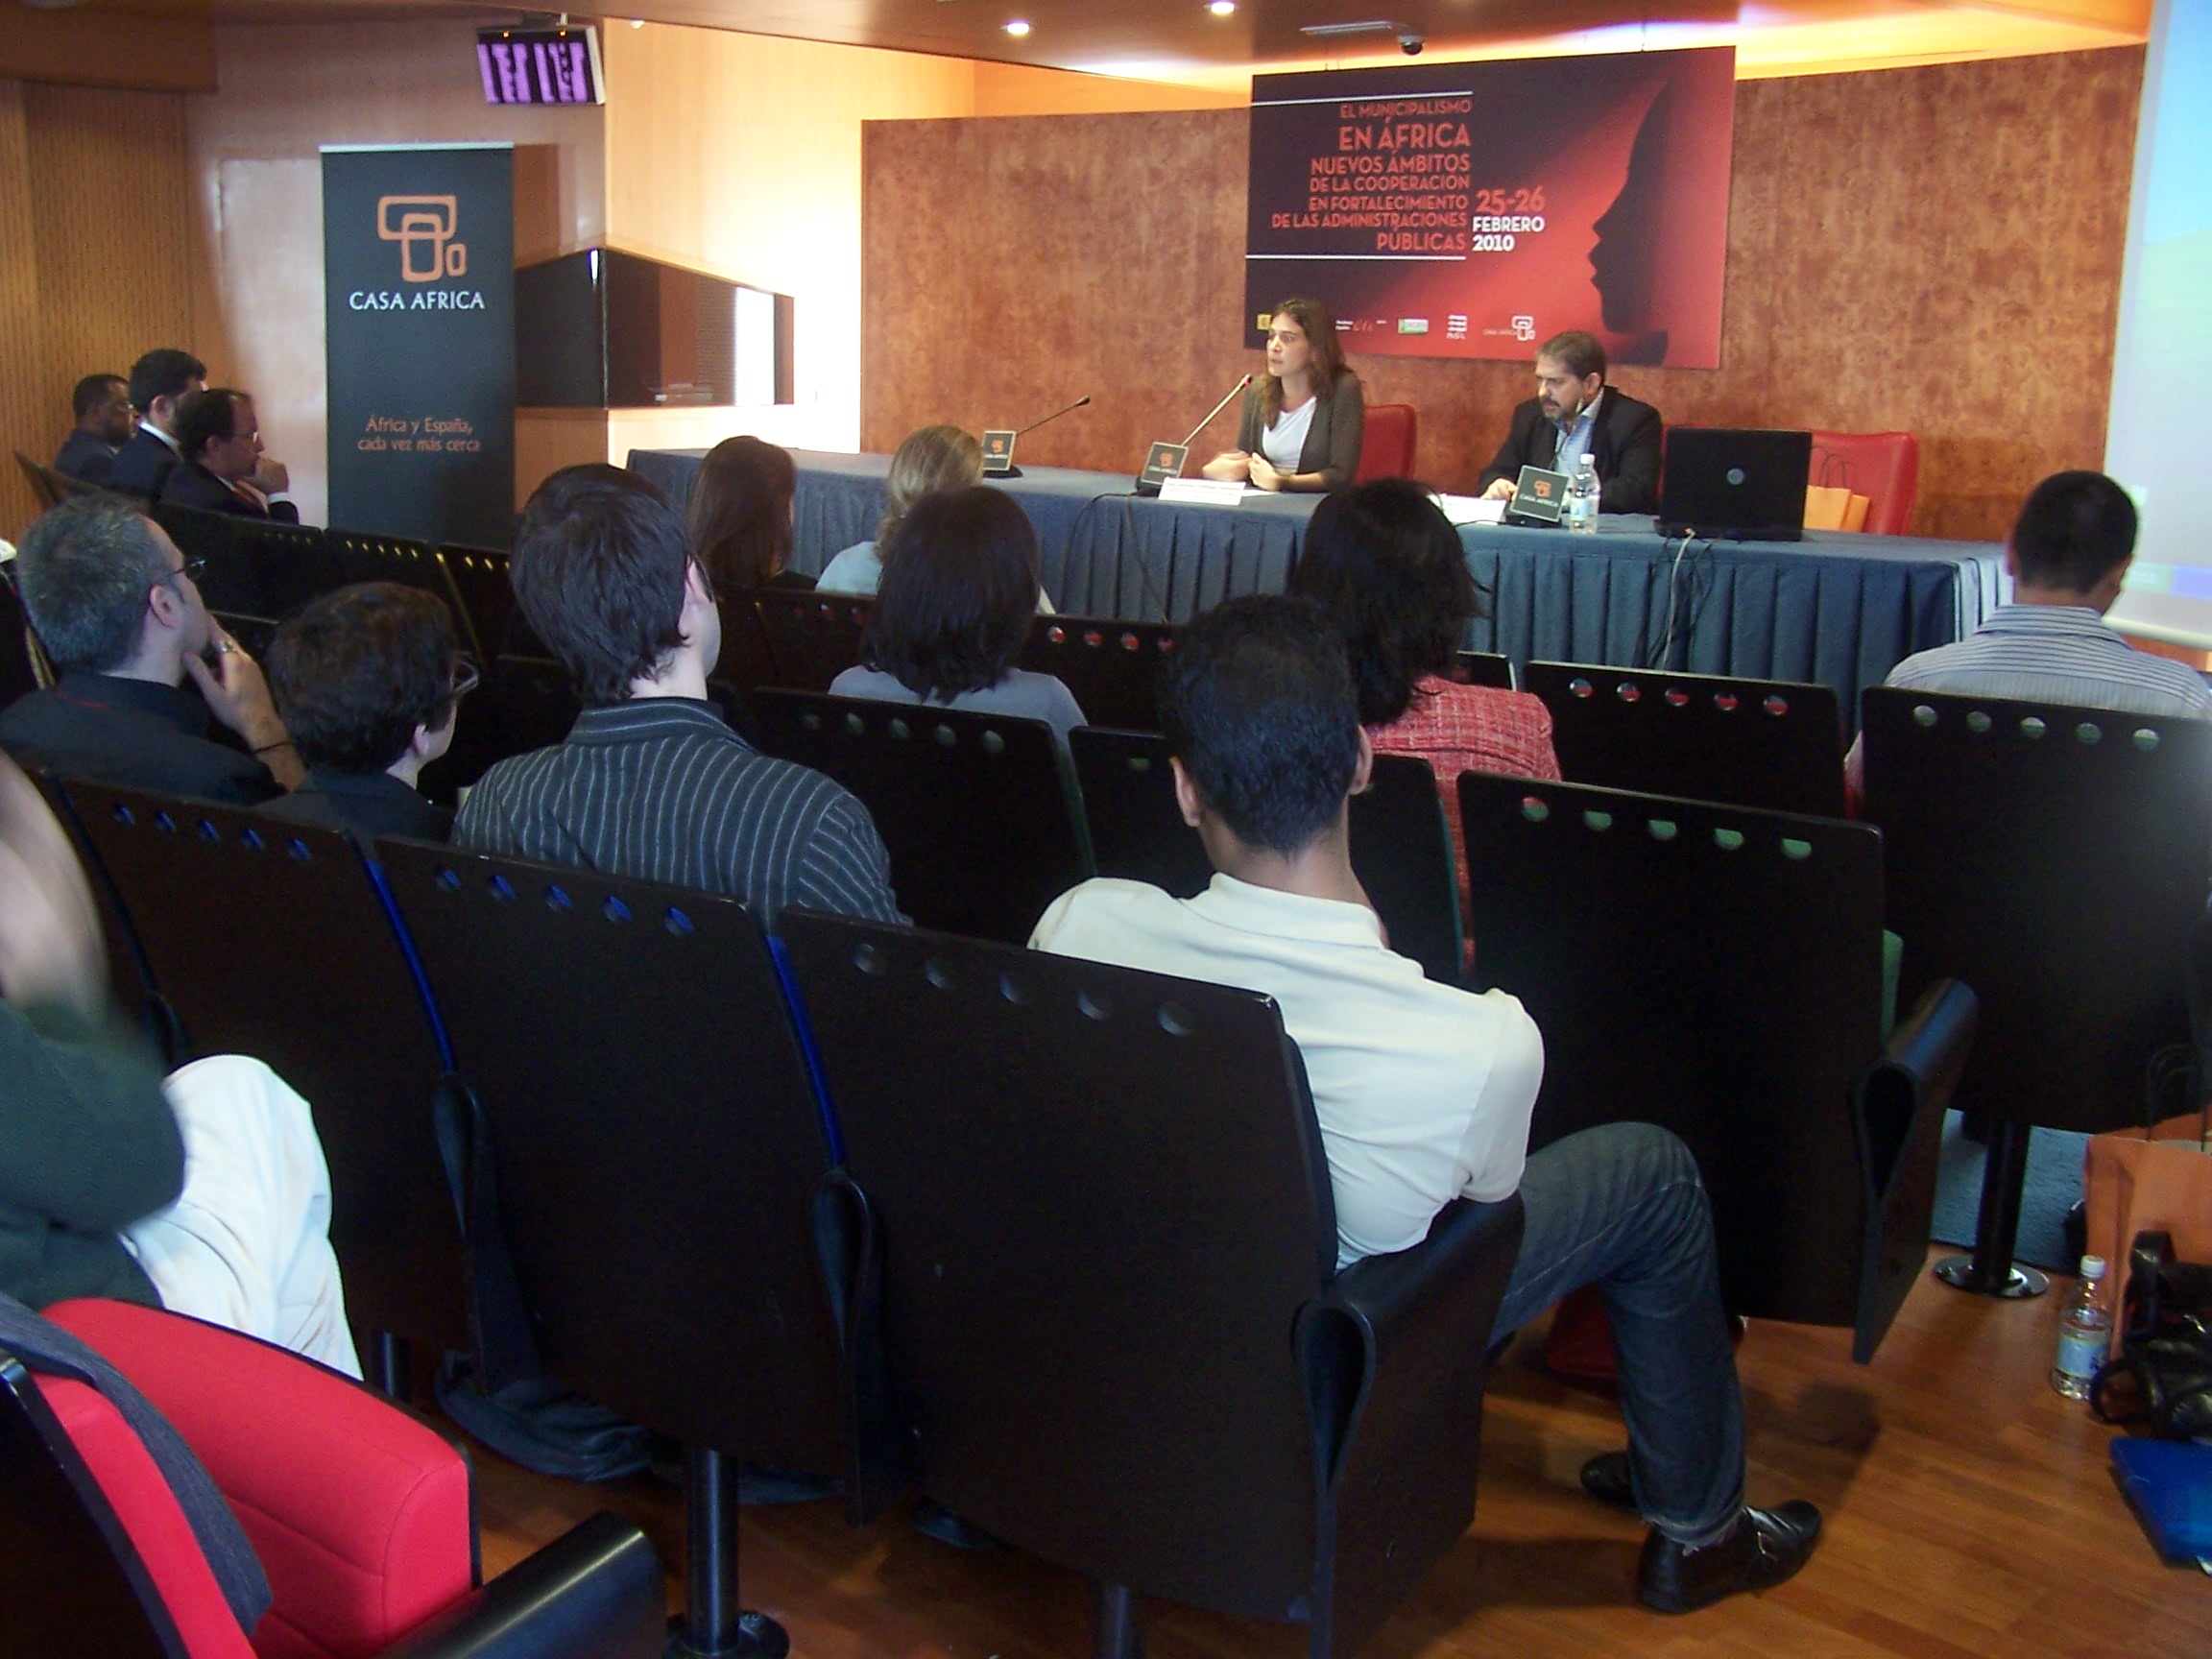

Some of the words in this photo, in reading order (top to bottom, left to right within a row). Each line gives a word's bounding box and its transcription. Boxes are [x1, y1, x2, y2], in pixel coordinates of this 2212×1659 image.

[1339, 102, 1357, 118] EL
[1339, 125, 1373, 151] EN
[1378, 116, 1472, 150] ÁFRICA
[1311, 156, 1382, 175] NUEVOS
[1385, 150, 1471, 173] ÁMBITOS
[1310, 177, 1329, 192] DE
[1333, 178, 1351, 191] LA
[1310, 196, 1329, 211] EN
[1331, 195, 1469, 210] FORTALECIMIENTO
[1476, 185, 1545, 214] 25-26
[1272, 213, 1288, 228] DE
[1293, 213, 1319, 228] LAS
[1473, 216, 1545, 232] FEBRERO
[1473, 235, 1515, 252] 2010
[349, 291, 405, 310] CASA
[411, 290, 486, 310] AFRICA
[411, 421, 420, 434] y
[358, 436, 387, 451] cada
[391, 438, 413, 451] vez
[446, 439, 480, 452] cerca
